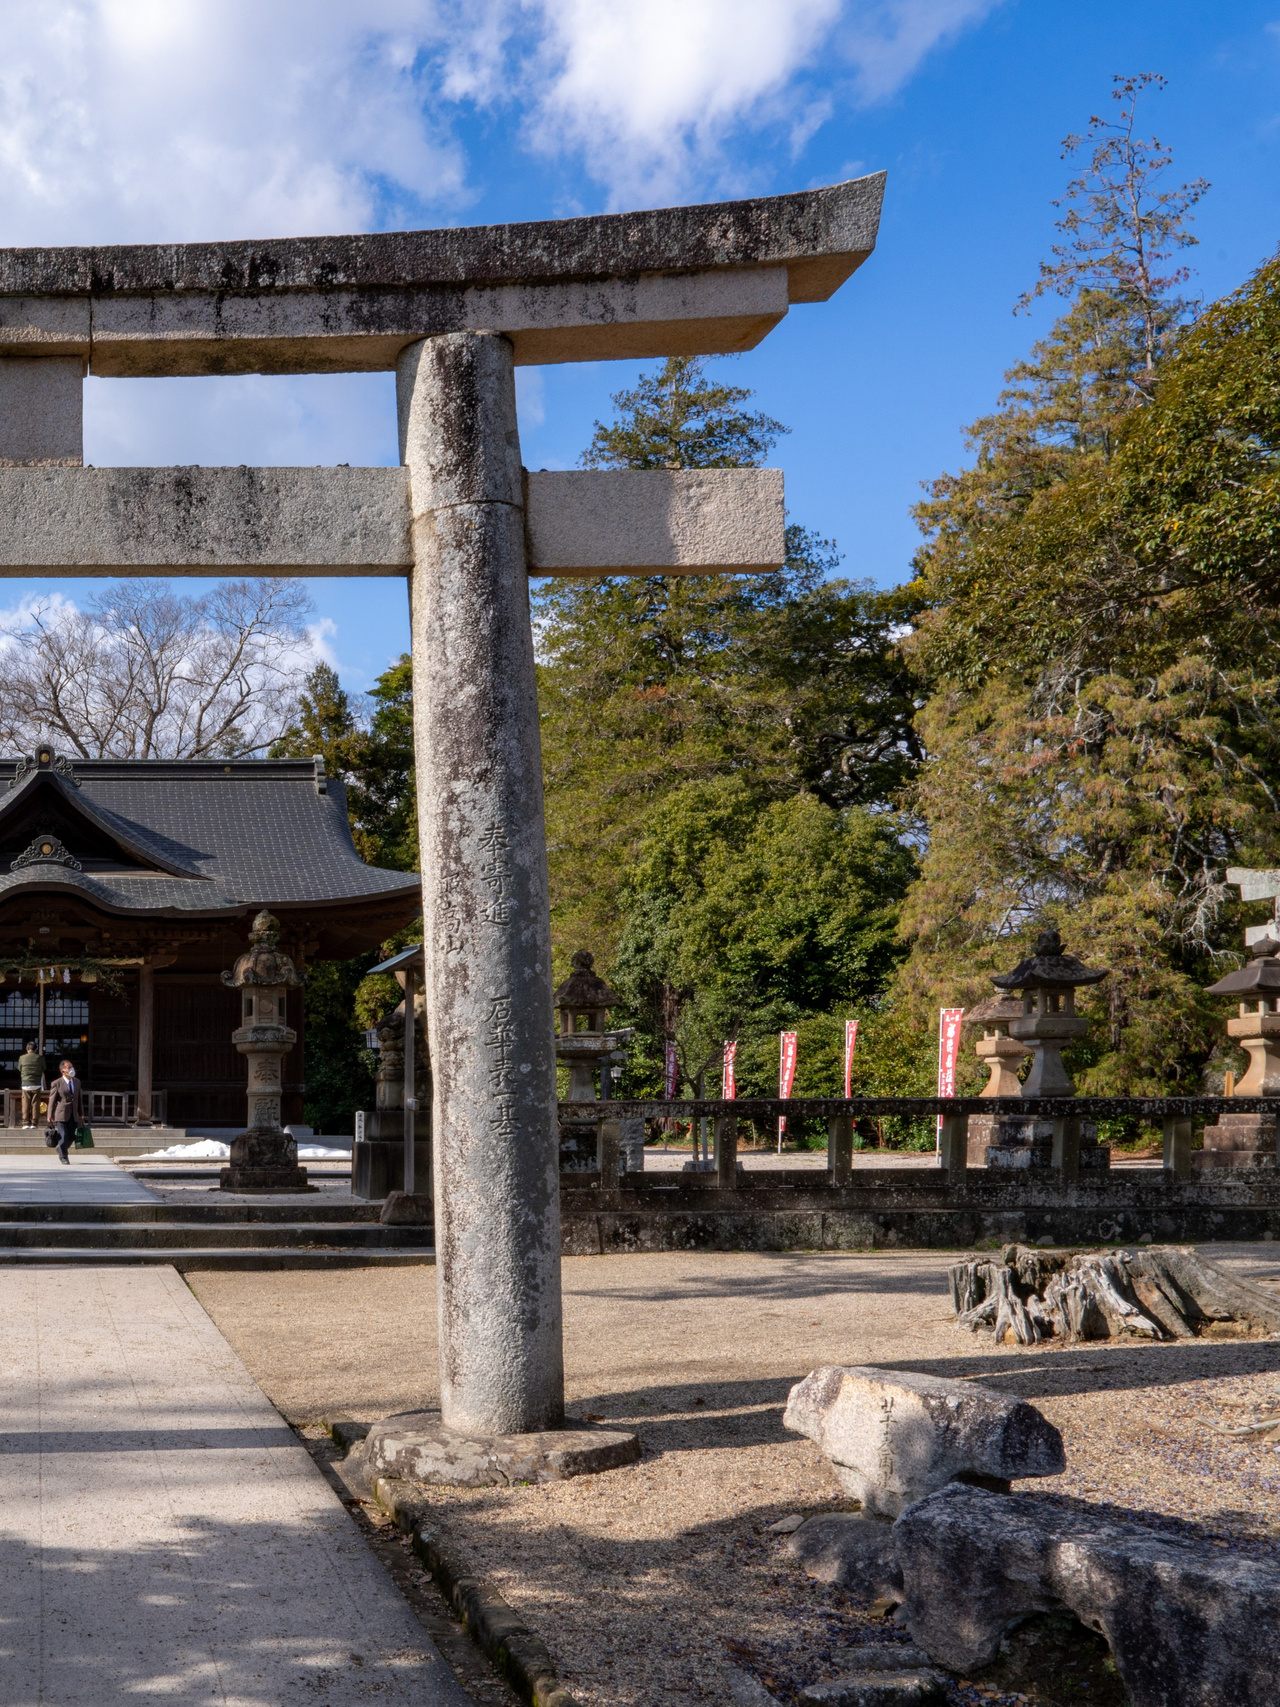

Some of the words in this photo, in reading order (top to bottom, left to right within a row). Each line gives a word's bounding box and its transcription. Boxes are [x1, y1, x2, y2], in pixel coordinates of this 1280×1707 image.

[478, 822, 512, 927] 奉寄進
[485, 995, 521, 1137] 石華表一基
